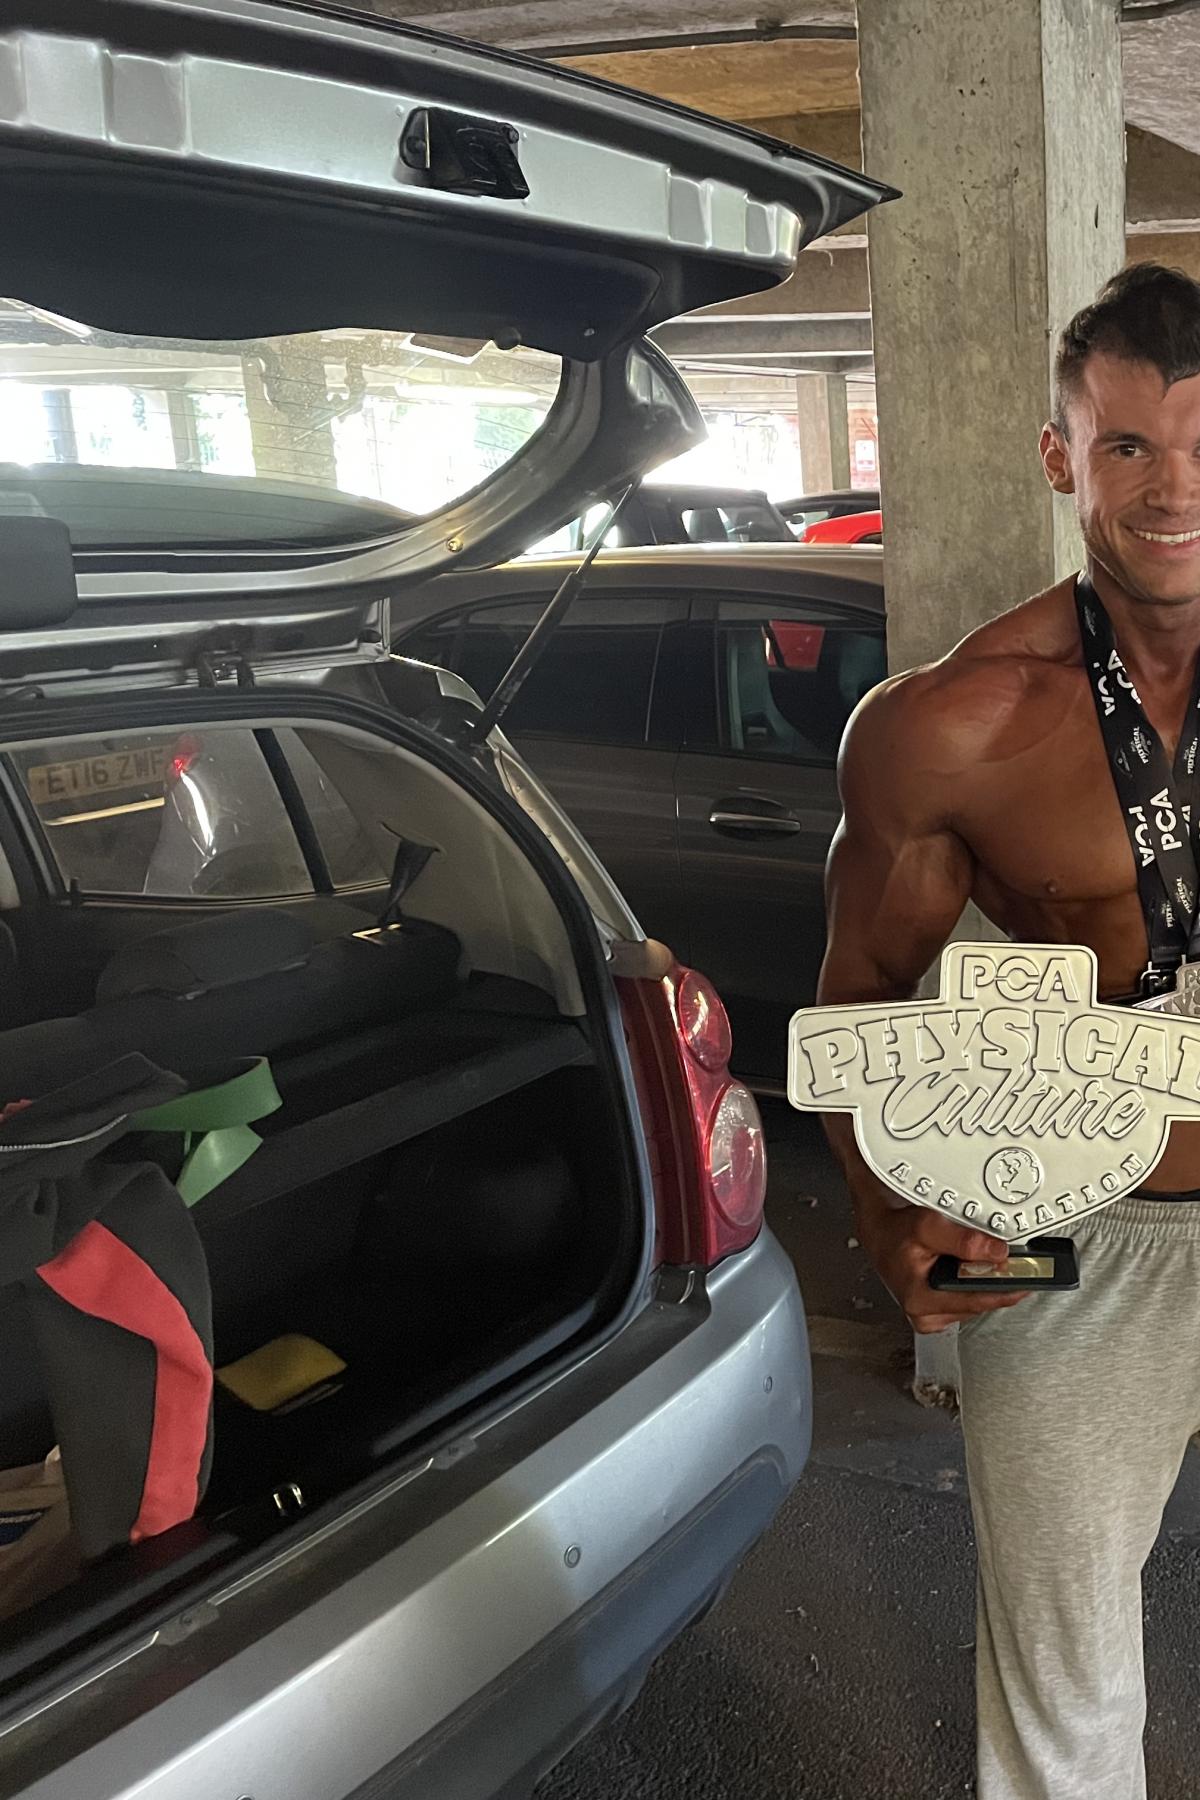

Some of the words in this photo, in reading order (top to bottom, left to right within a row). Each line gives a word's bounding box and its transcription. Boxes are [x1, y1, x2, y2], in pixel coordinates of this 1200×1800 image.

[46, 758, 109, 795] ET16
[1150, 787, 1183, 851] PCA
[961, 954, 1080, 1002] PCA
[882, 1065, 1149, 1139] Culture
[890, 1153, 1146, 1231] ASSOCIATION
